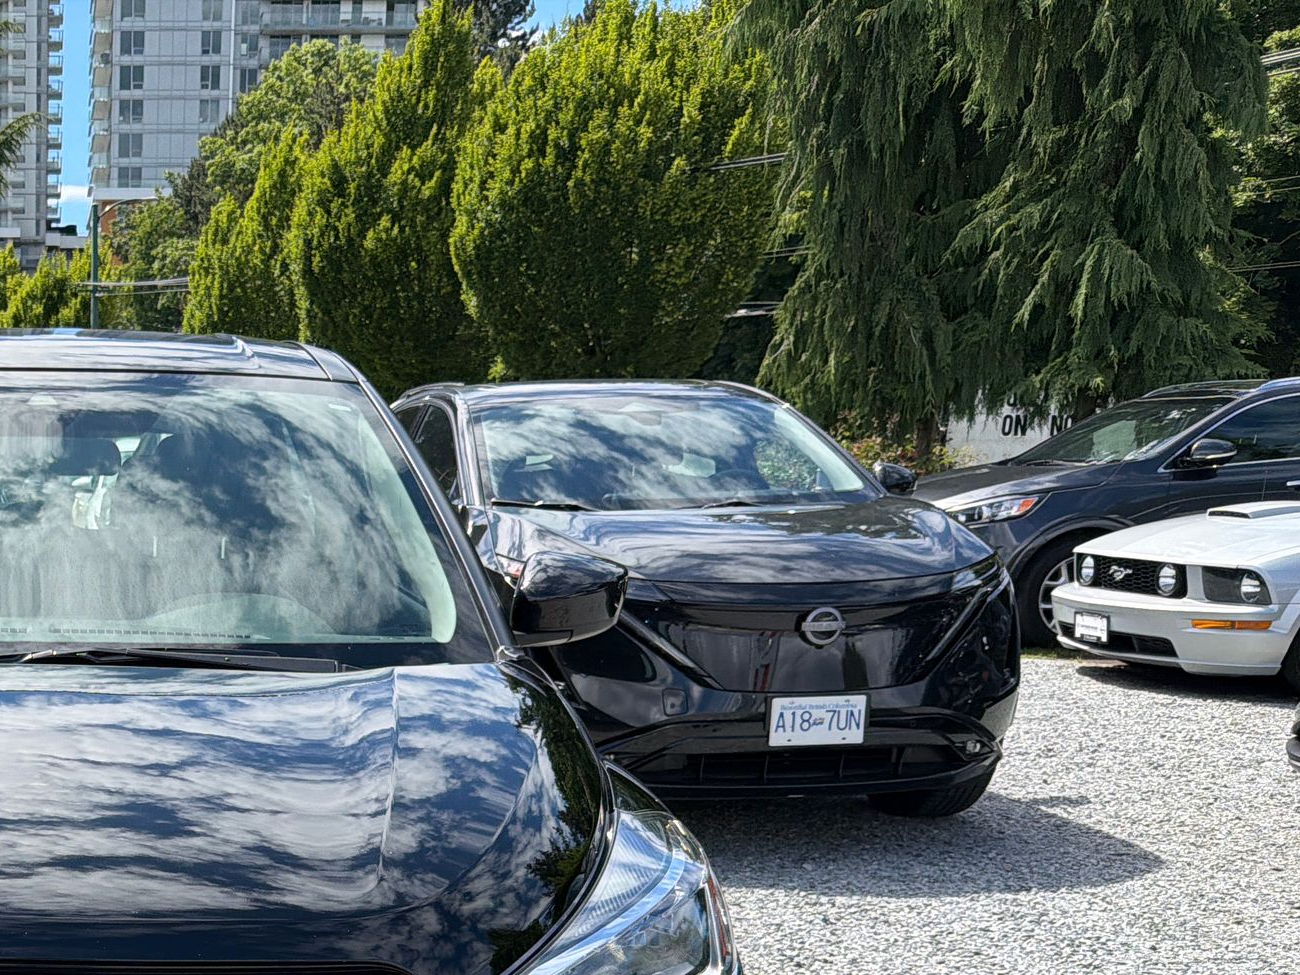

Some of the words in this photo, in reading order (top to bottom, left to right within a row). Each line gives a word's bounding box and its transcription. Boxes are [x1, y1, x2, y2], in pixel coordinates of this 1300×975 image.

[1001, 415, 1027, 436] ON
[775, 711, 812, 732] A18
[826, 709, 861, 731] 7UN
